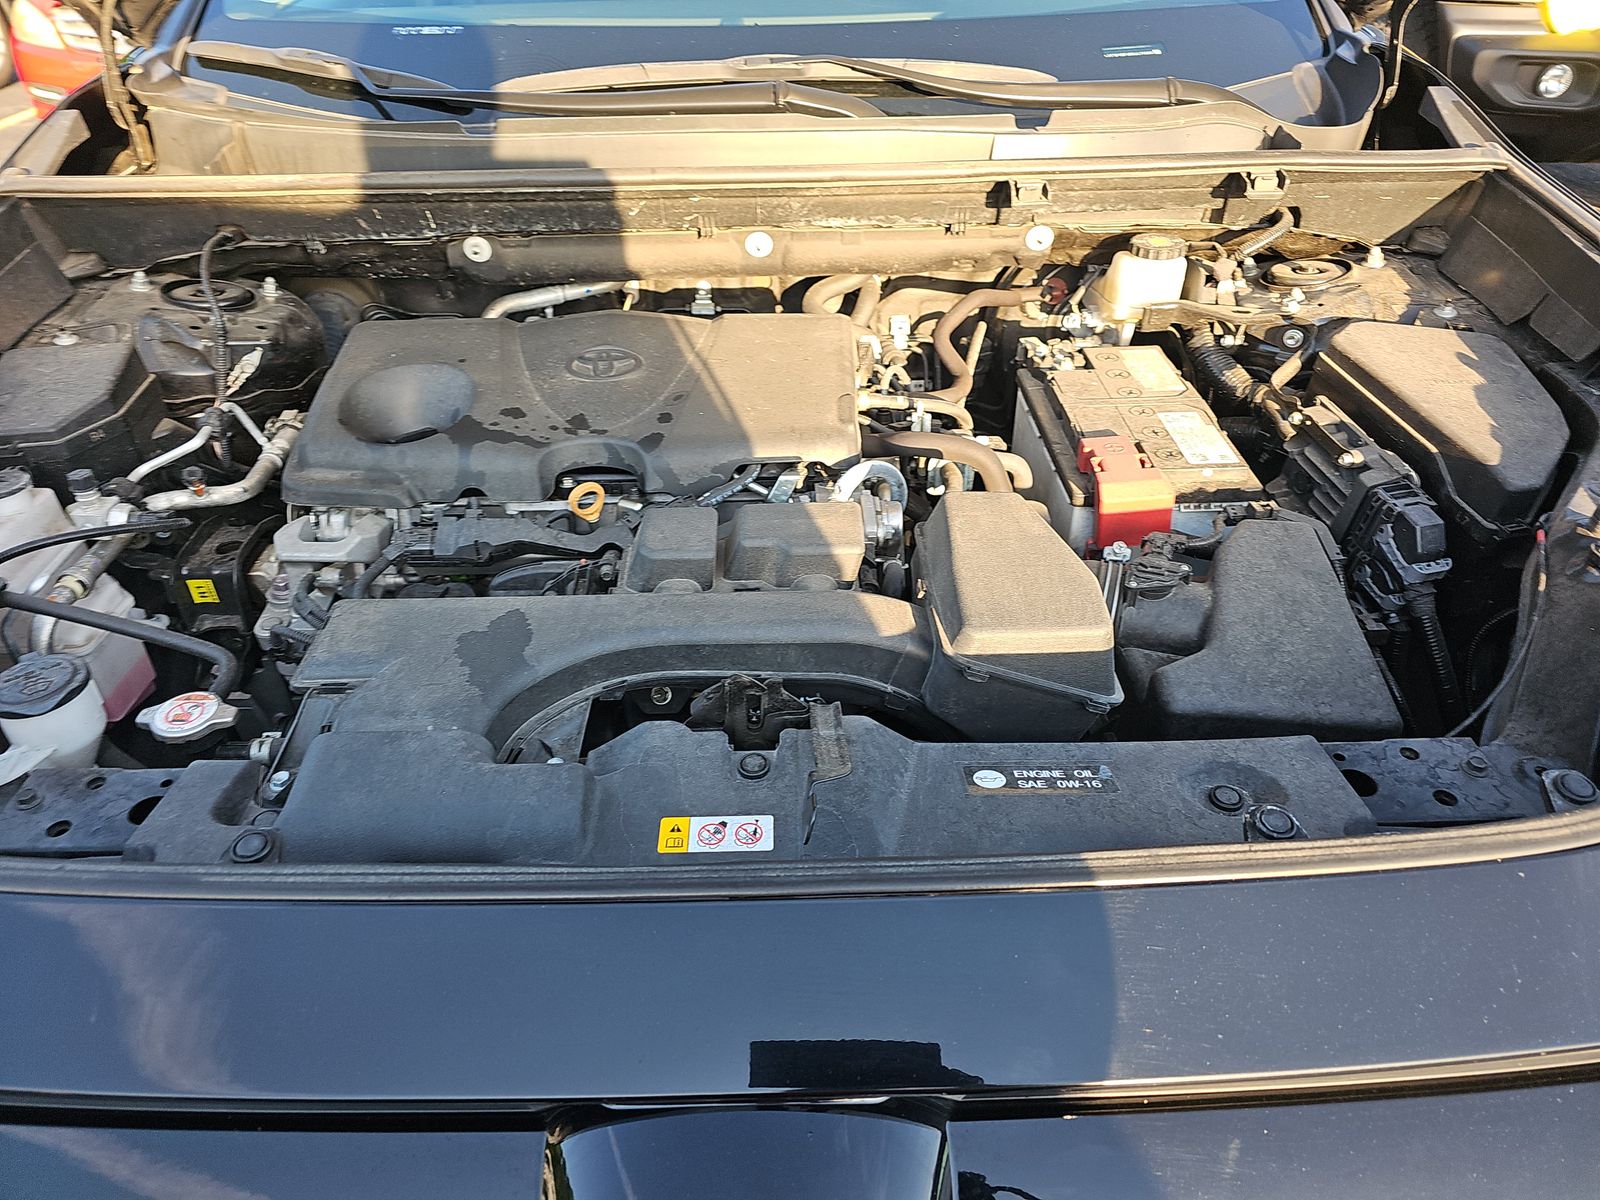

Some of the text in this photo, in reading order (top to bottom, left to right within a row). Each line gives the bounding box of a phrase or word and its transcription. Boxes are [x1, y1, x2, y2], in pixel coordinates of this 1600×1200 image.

[1013, 770, 1099, 778] ENGINE OIL
[1017, 780, 1103, 788] SAE 0W-16
